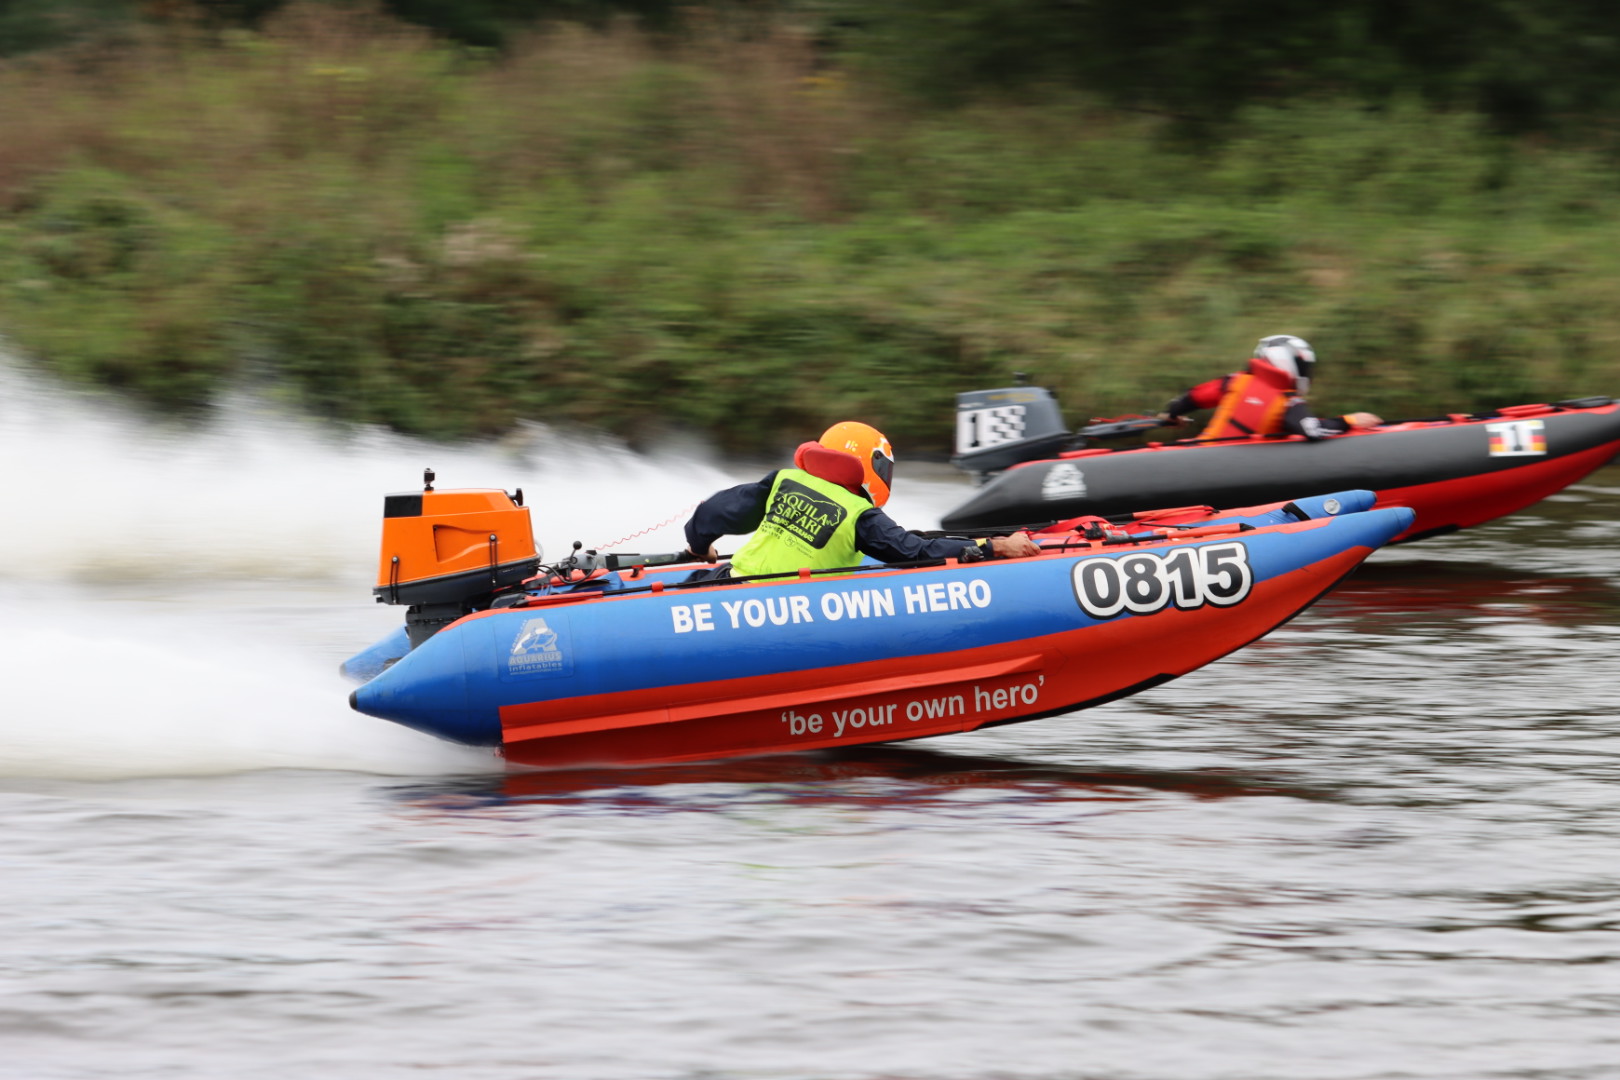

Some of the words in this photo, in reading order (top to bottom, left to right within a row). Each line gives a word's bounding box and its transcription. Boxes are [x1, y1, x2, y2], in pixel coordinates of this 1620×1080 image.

[969, 414, 980, 448] 1
[1510, 424, 1524, 452] 1
[774, 503, 823, 536] SAFARI
[777, 492, 828, 527] AQUILA
[1075, 543, 1249, 614] 0815
[670, 603, 715, 634] BE
[720, 595, 814, 629] YOUR
[820, 588, 896, 621] OWN
[903, 578, 992, 615] HERO
[508, 651, 563, 666] AQUARIUS
[832, 703, 898, 738] your
[906, 694, 966, 722] own
